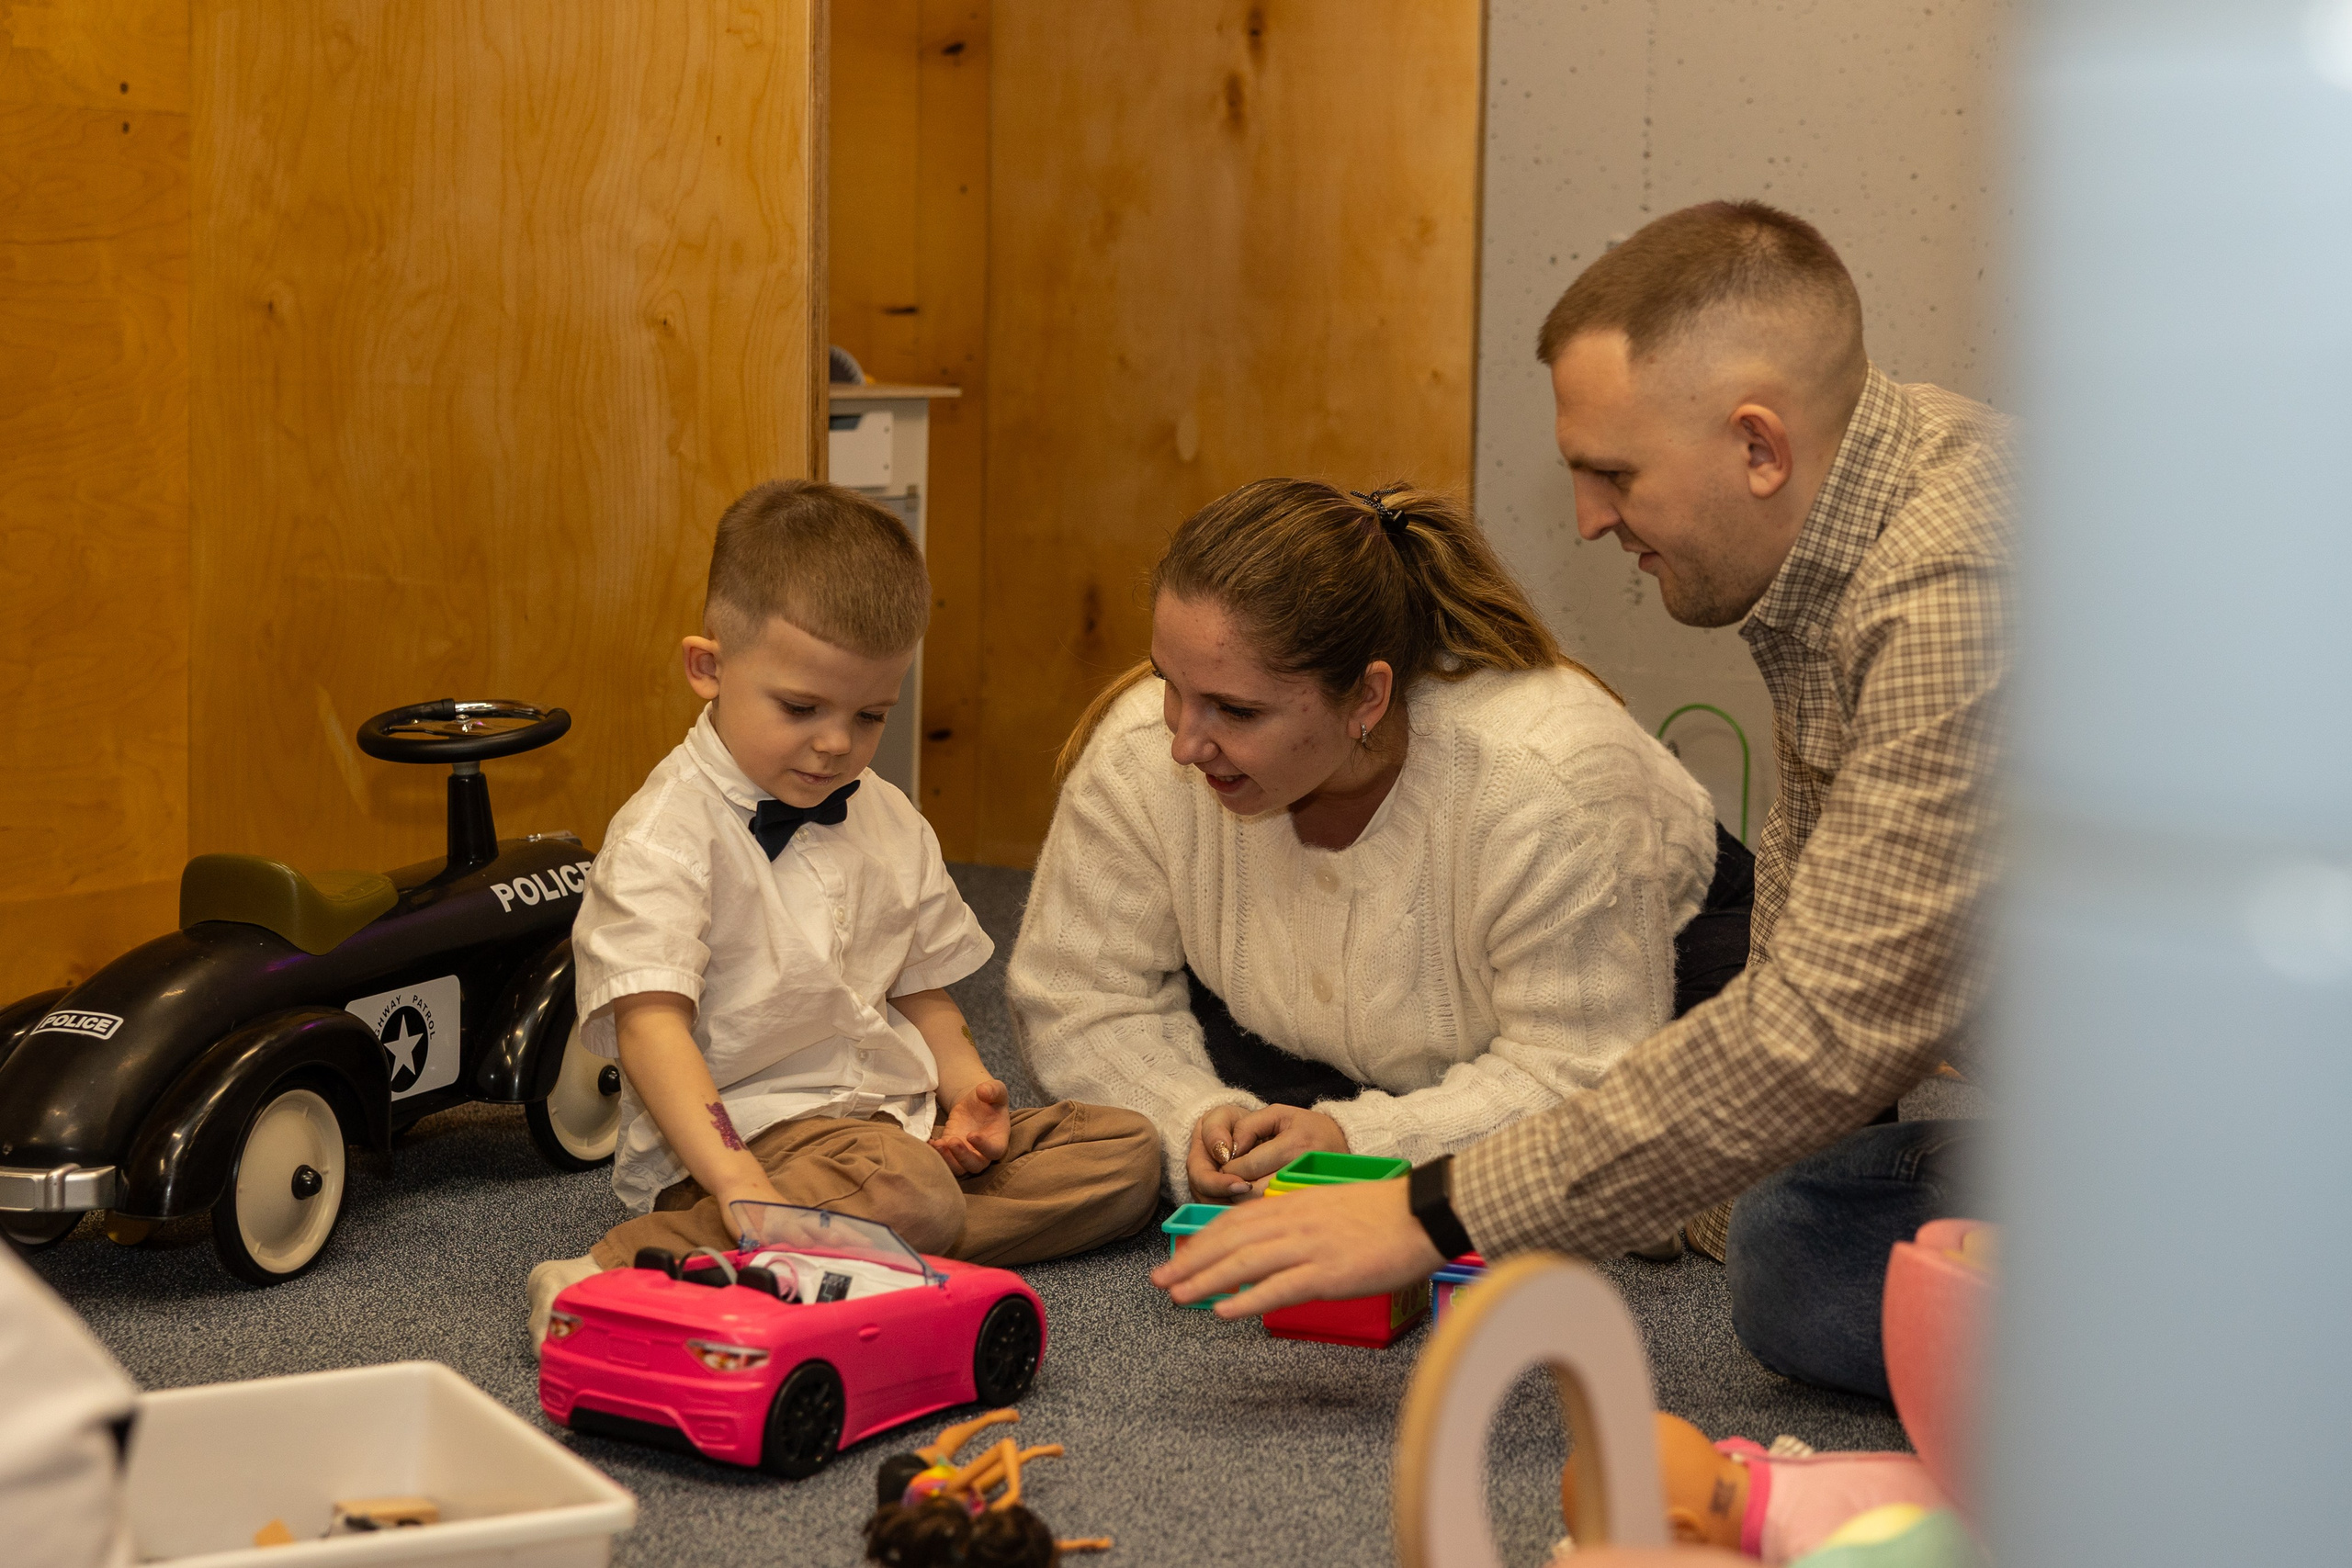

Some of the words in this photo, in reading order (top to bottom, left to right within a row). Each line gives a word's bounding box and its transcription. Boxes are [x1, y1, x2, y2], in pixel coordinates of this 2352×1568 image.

[40, 1014, 114, 1033] POLICE
[374, 995, 401, 1038] GHWAY
[413, 995, 435, 1040] PATROL
